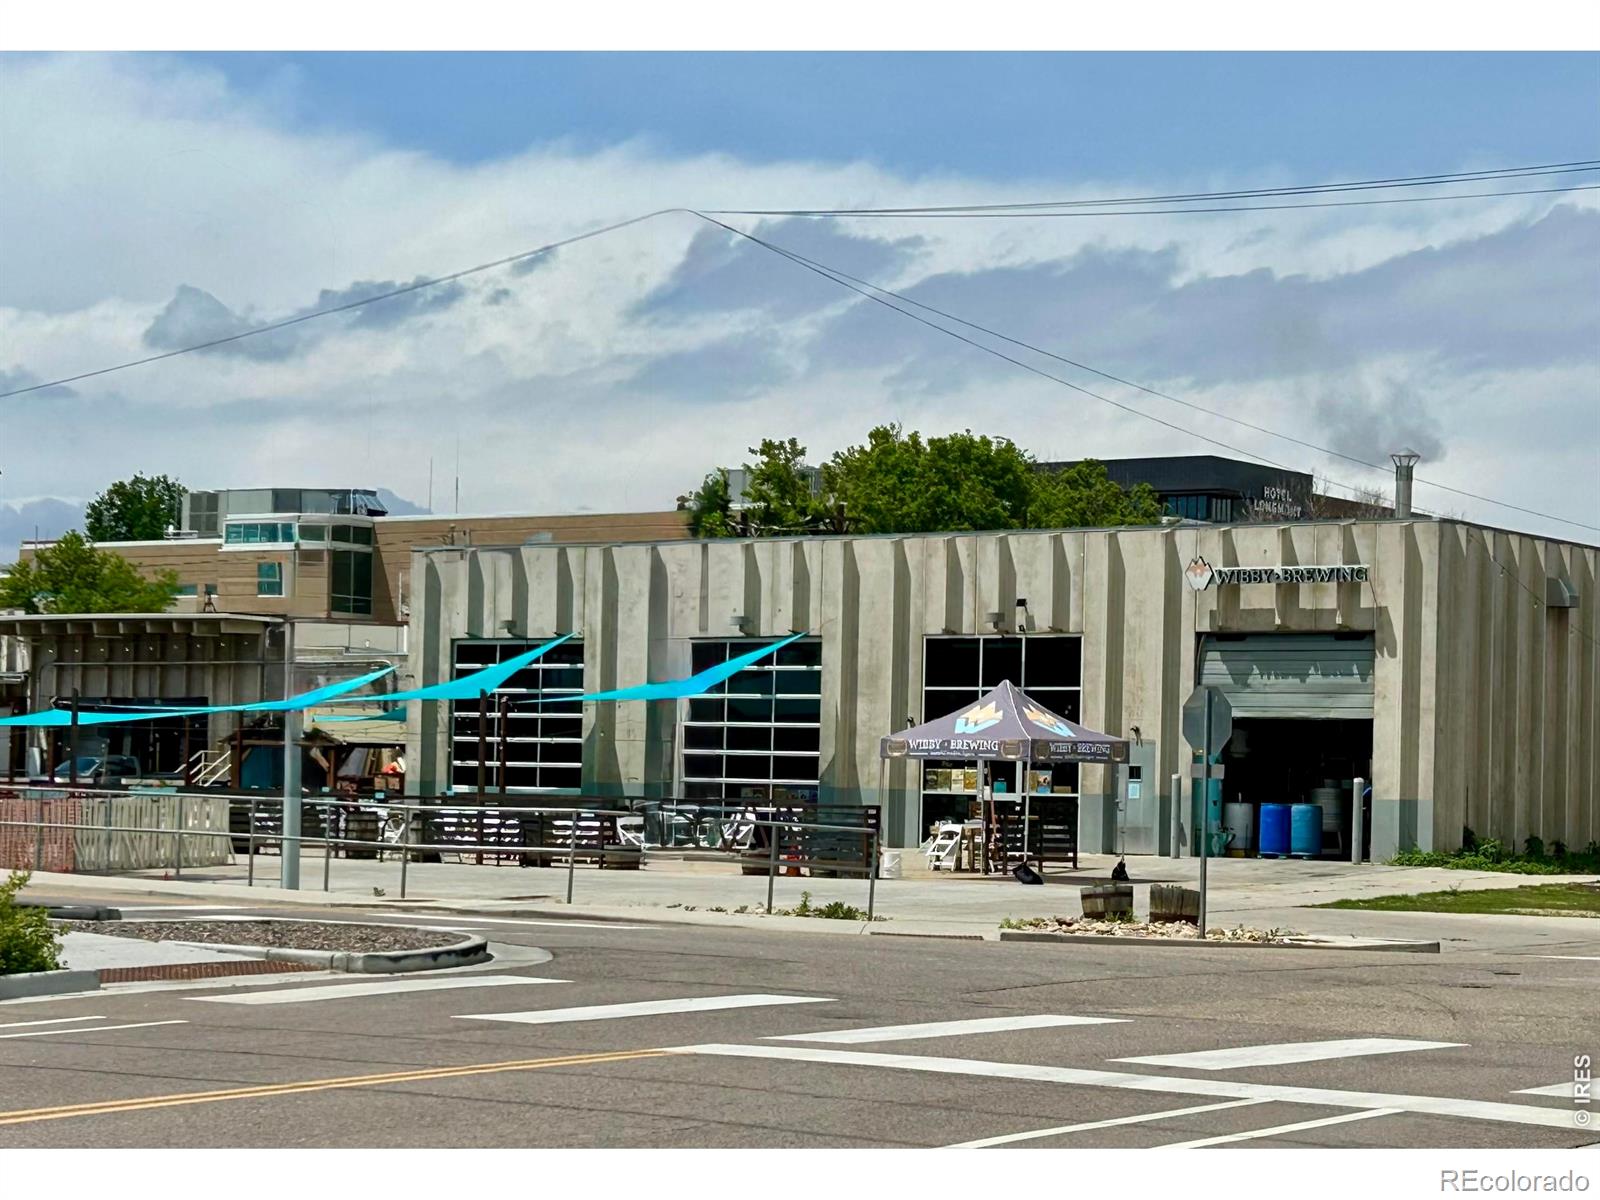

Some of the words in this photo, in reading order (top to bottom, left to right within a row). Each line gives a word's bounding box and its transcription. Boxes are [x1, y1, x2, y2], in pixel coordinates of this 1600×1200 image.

[1263, 486, 1292, 502] HOTEL
[1212, 568, 1275, 585] WIBBY
[1280, 566, 1368, 583] BREWING
[949, 739, 999, 751] BREWING
